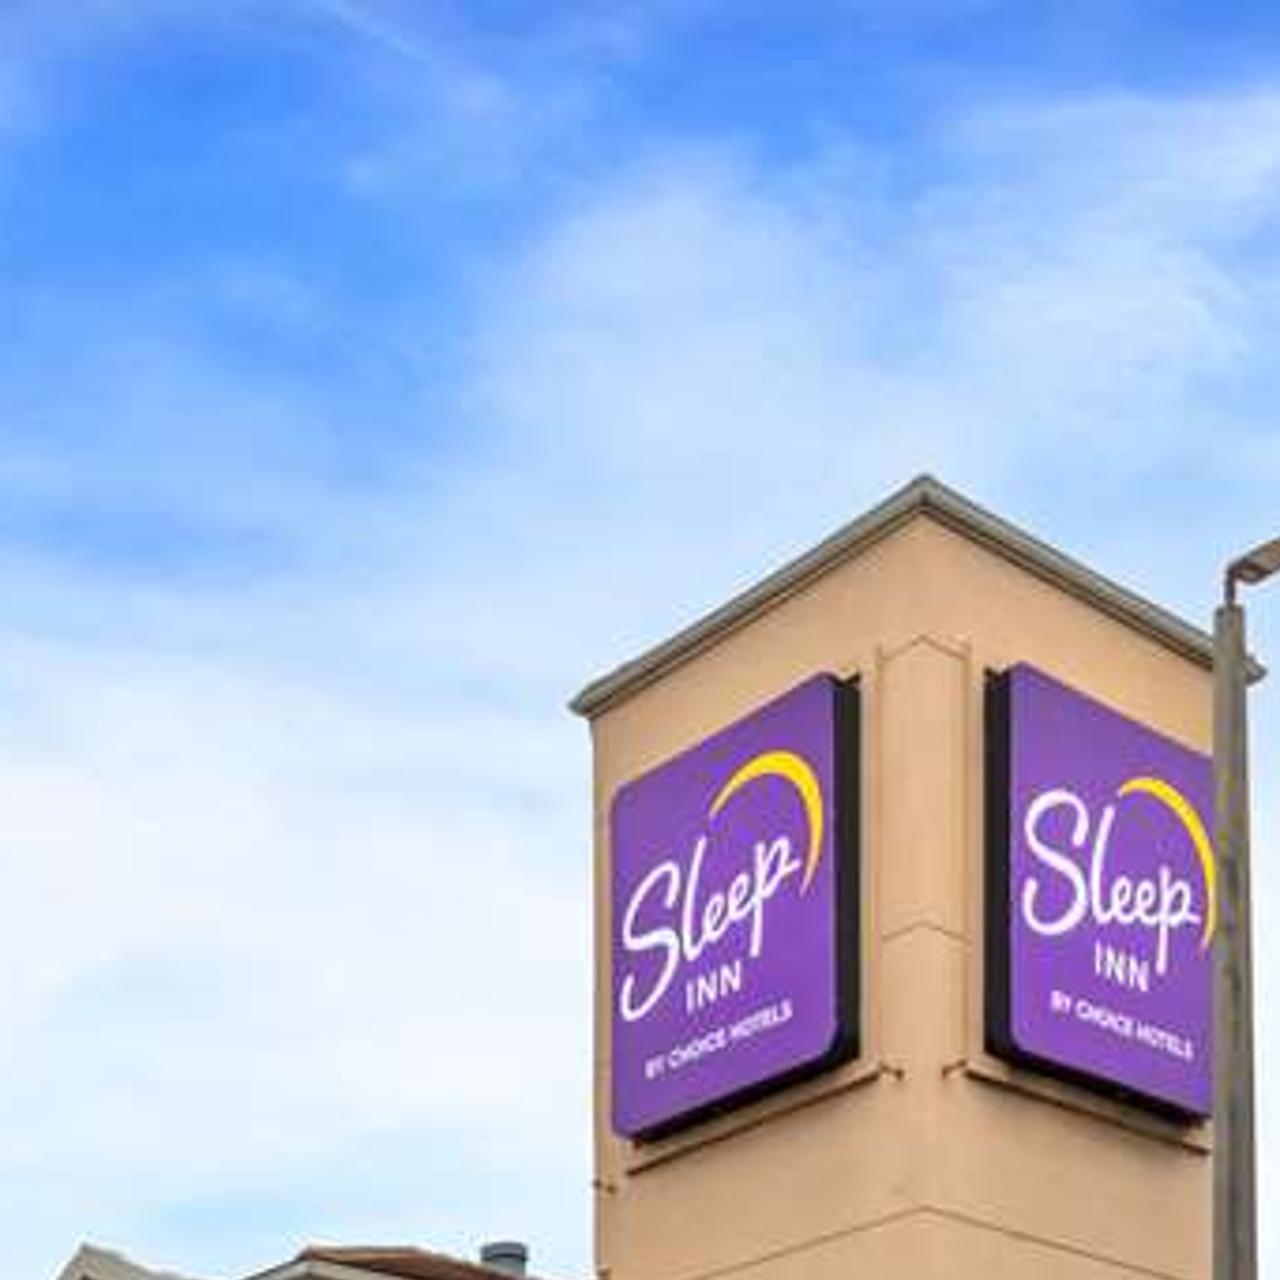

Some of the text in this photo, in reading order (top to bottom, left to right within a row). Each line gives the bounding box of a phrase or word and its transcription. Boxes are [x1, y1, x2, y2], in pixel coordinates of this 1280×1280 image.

[1022, 788, 1201, 975] Sleep
[621, 834, 801, 1022] Sleep
[685, 960, 743, 1015] INN
[1094, 939, 1150, 992] INN
[1050, 989, 1195, 1062] BY CHOICE HOTELS
